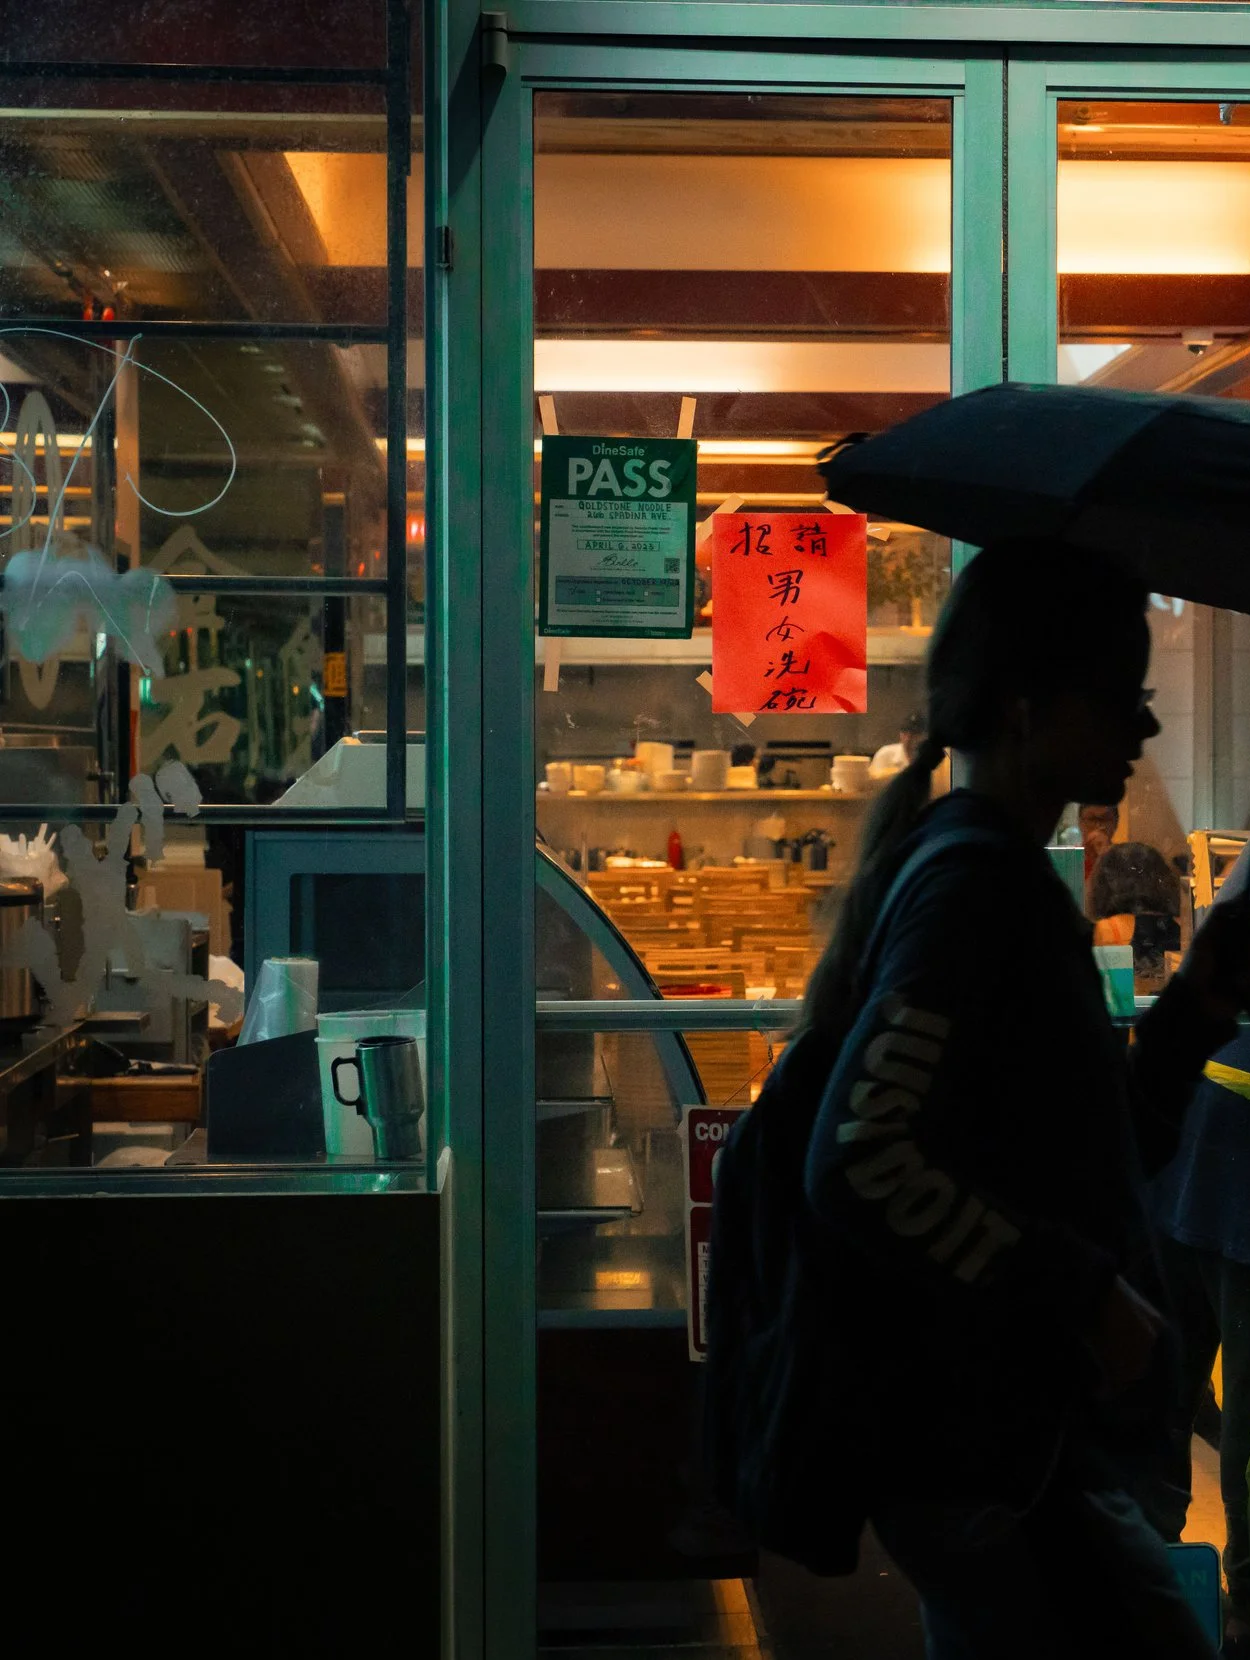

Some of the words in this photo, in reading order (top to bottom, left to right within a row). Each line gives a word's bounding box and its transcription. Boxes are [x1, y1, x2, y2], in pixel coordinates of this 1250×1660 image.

[592, 443, 645, 456] DineSafe
[568, 457, 672, 498] PASS
[578, 501, 631, 512] GOLDSTONE
[638, 503, 671, 512] NOODLE
[609, 512, 646, 520] SPADINA
[585, 540, 612, 550] APRIL
[927, 1193, 1023, 1283] IT
